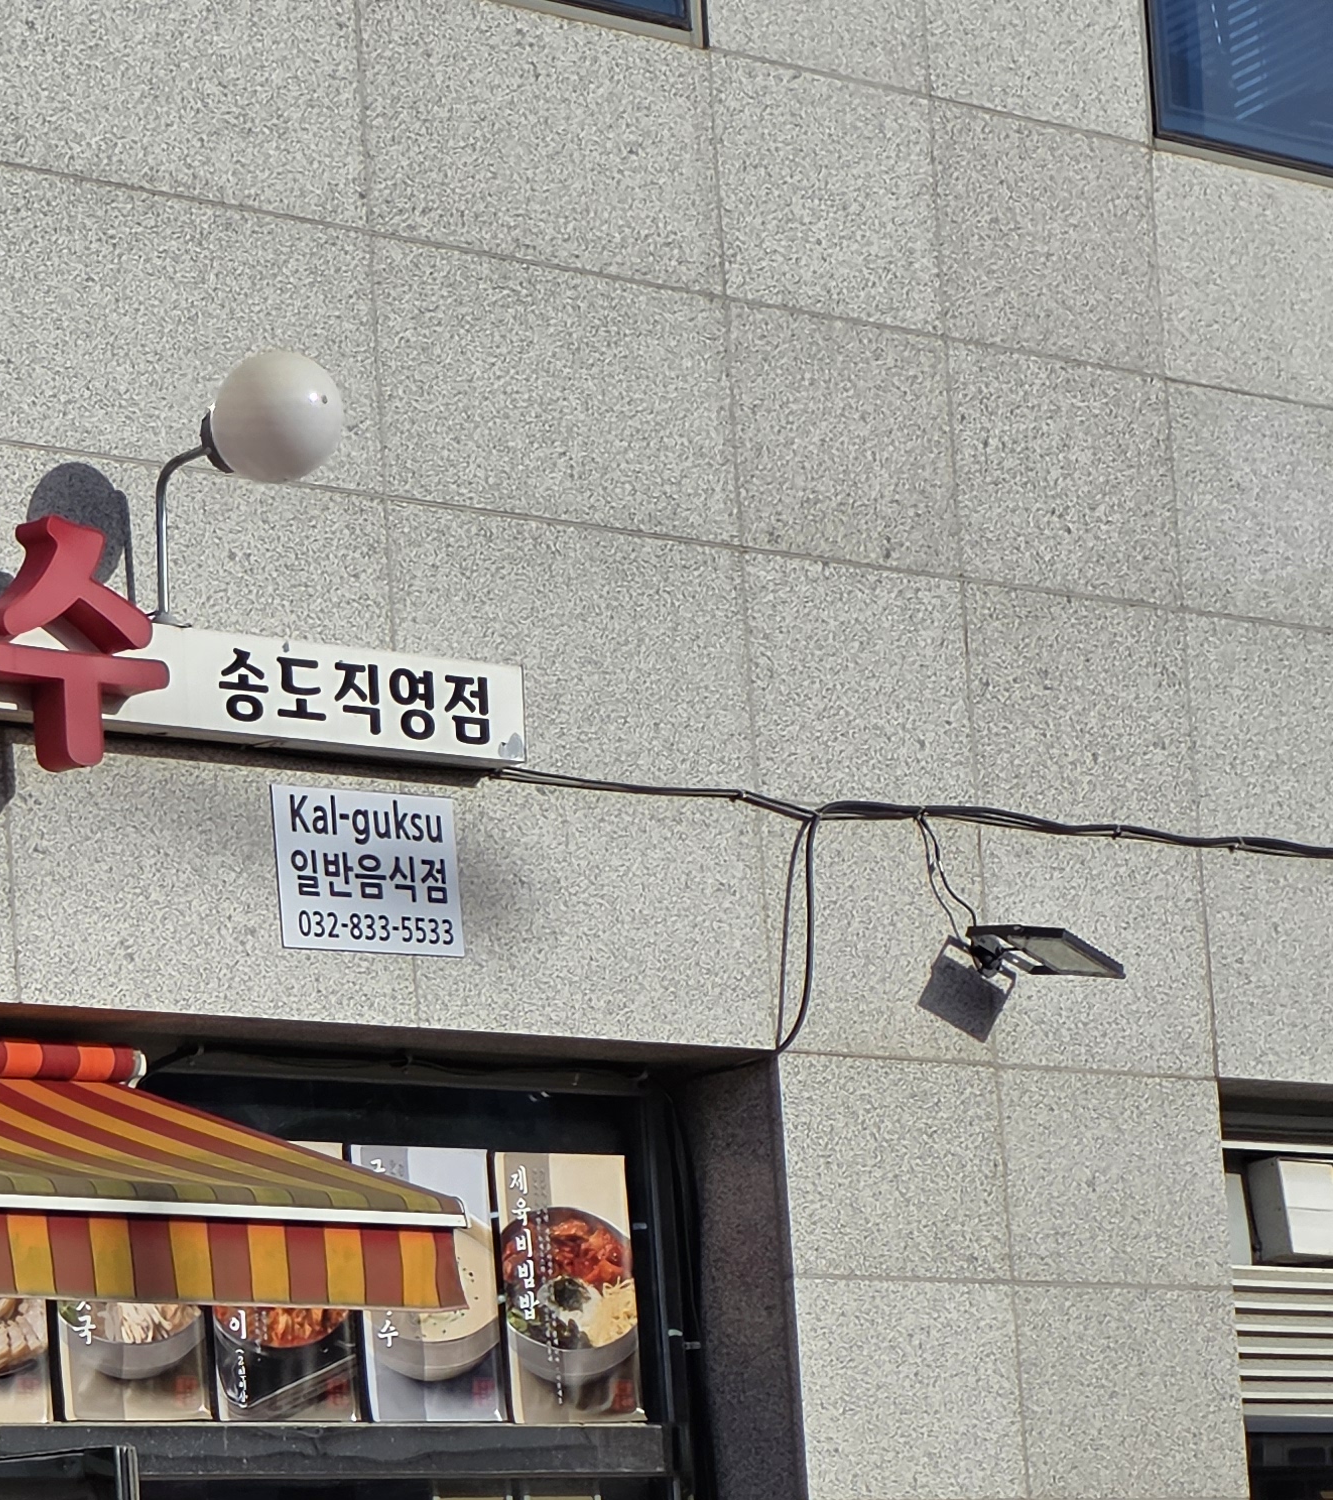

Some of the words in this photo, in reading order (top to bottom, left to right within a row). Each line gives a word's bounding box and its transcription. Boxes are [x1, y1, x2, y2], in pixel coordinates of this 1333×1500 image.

[218, 647, 491, 745] 송도직영점
[288, 793, 444, 845] Kal-guksu
[290, 849, 449, 904] 일반음식점
[298, 910, 454, 946] 032-833-5533
[509, 1165, 540, 1321] 제육비빔밥
